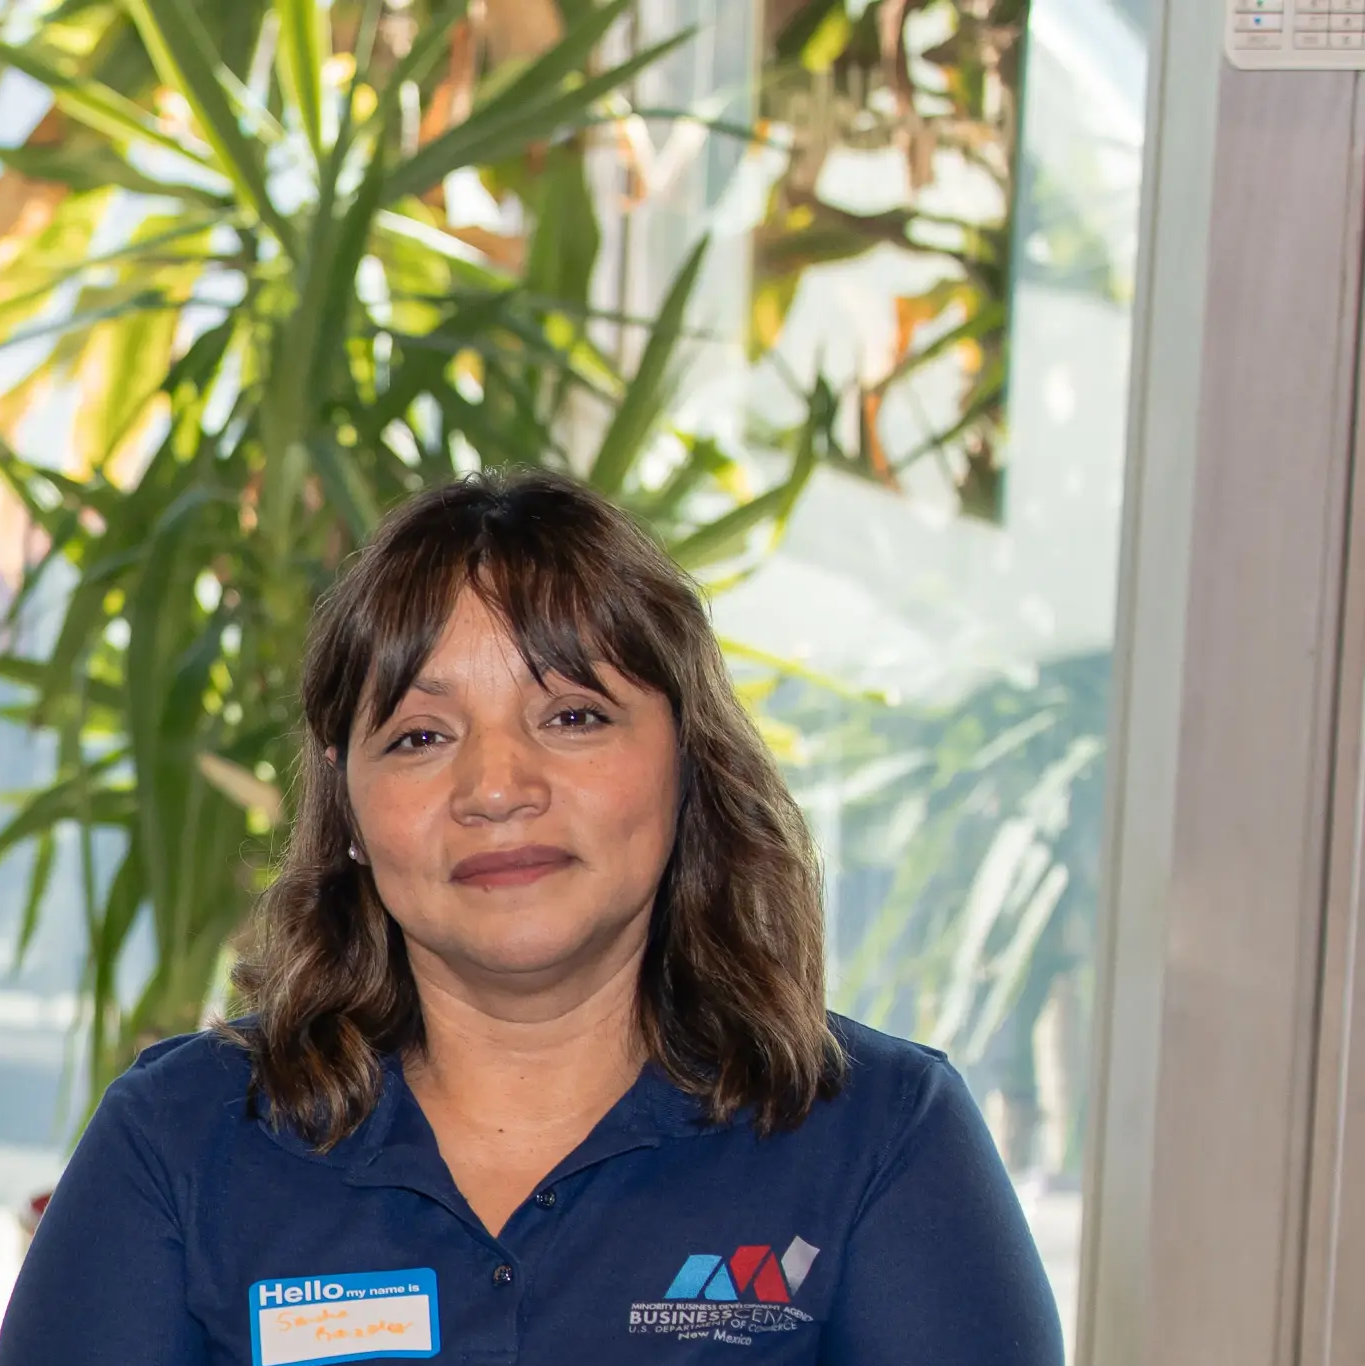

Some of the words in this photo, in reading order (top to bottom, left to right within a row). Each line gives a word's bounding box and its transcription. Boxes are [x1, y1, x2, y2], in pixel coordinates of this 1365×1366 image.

[259, 1280, 344, 1306] Hello
[346, 1288, 366, 1298] my
[370, 1285, 405, 1296] name
[408, 1283, 420, 1292] is
[631, 1303, 674, 1311] MINORITY
[676, 1303, 717, 1311] BUSINESS
[730, 1319, 746, 1329] OF
[677, 1331, 709, 1341] New
[713, 1328, 752, 1346] Mexico
